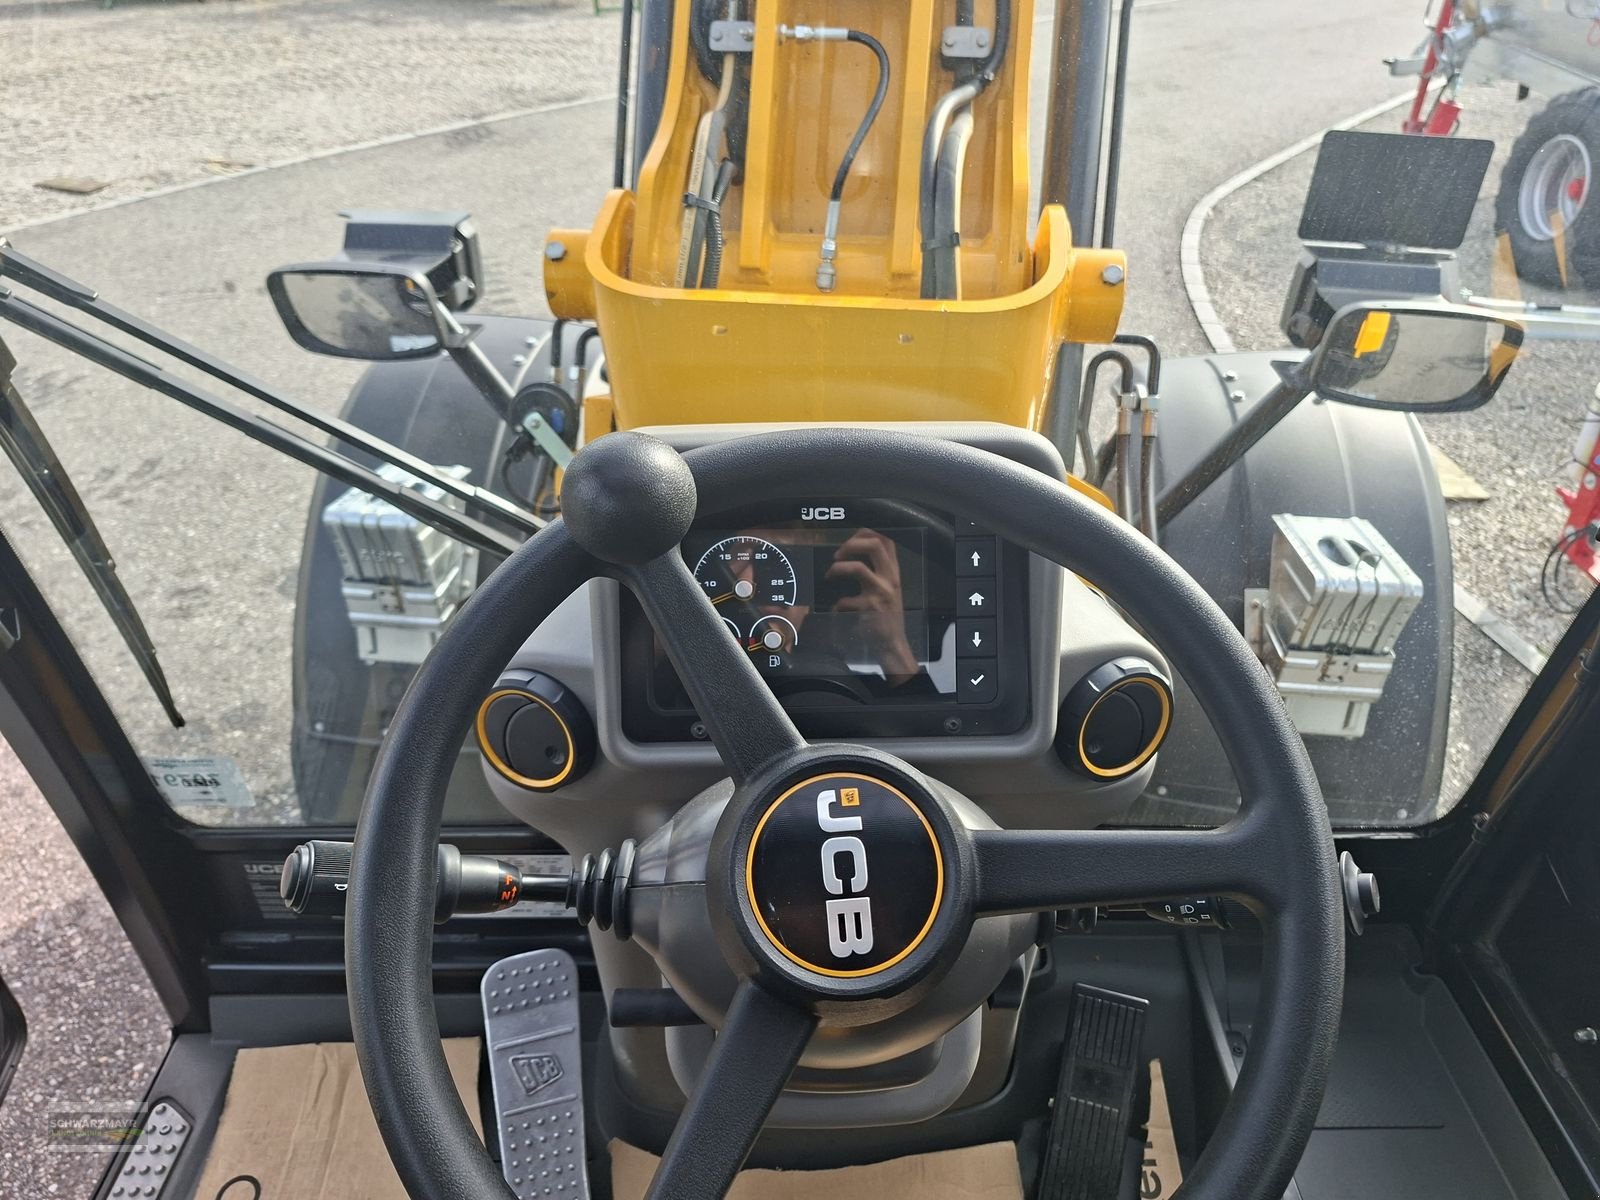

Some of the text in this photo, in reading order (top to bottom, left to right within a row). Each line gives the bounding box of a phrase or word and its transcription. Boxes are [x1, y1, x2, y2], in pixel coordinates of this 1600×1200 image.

[801, 507, 846, 521] JCB
[506, 874, 513, 885] F
[817, 788, 874, 958] JCB
[501, 891, 511, 900] N
[518, 1057, 558, 1089] JCB
